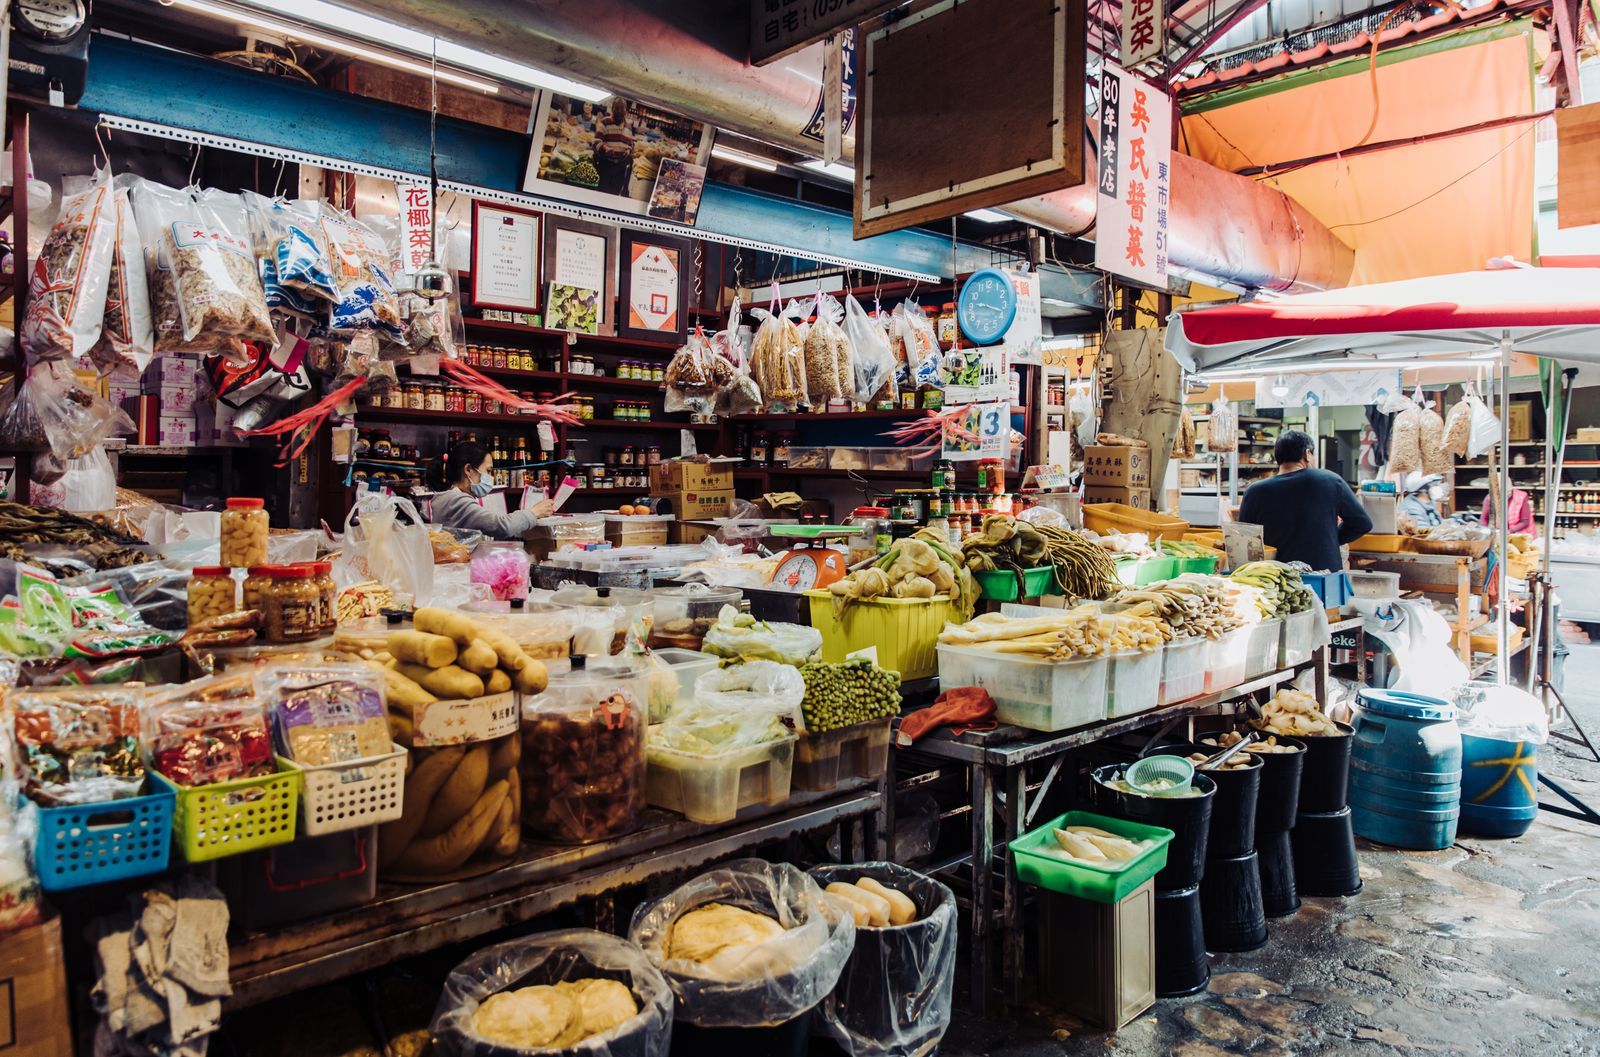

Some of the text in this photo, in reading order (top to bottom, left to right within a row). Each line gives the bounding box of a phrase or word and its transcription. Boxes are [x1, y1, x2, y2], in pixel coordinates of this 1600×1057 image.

[1101, 75, 1119, 193] 80年老店
[405, 188, 432, 270] 花椰菜乾
[984, 411, 1000, 436] 3
[1331, 635, 1356, 647] eke
